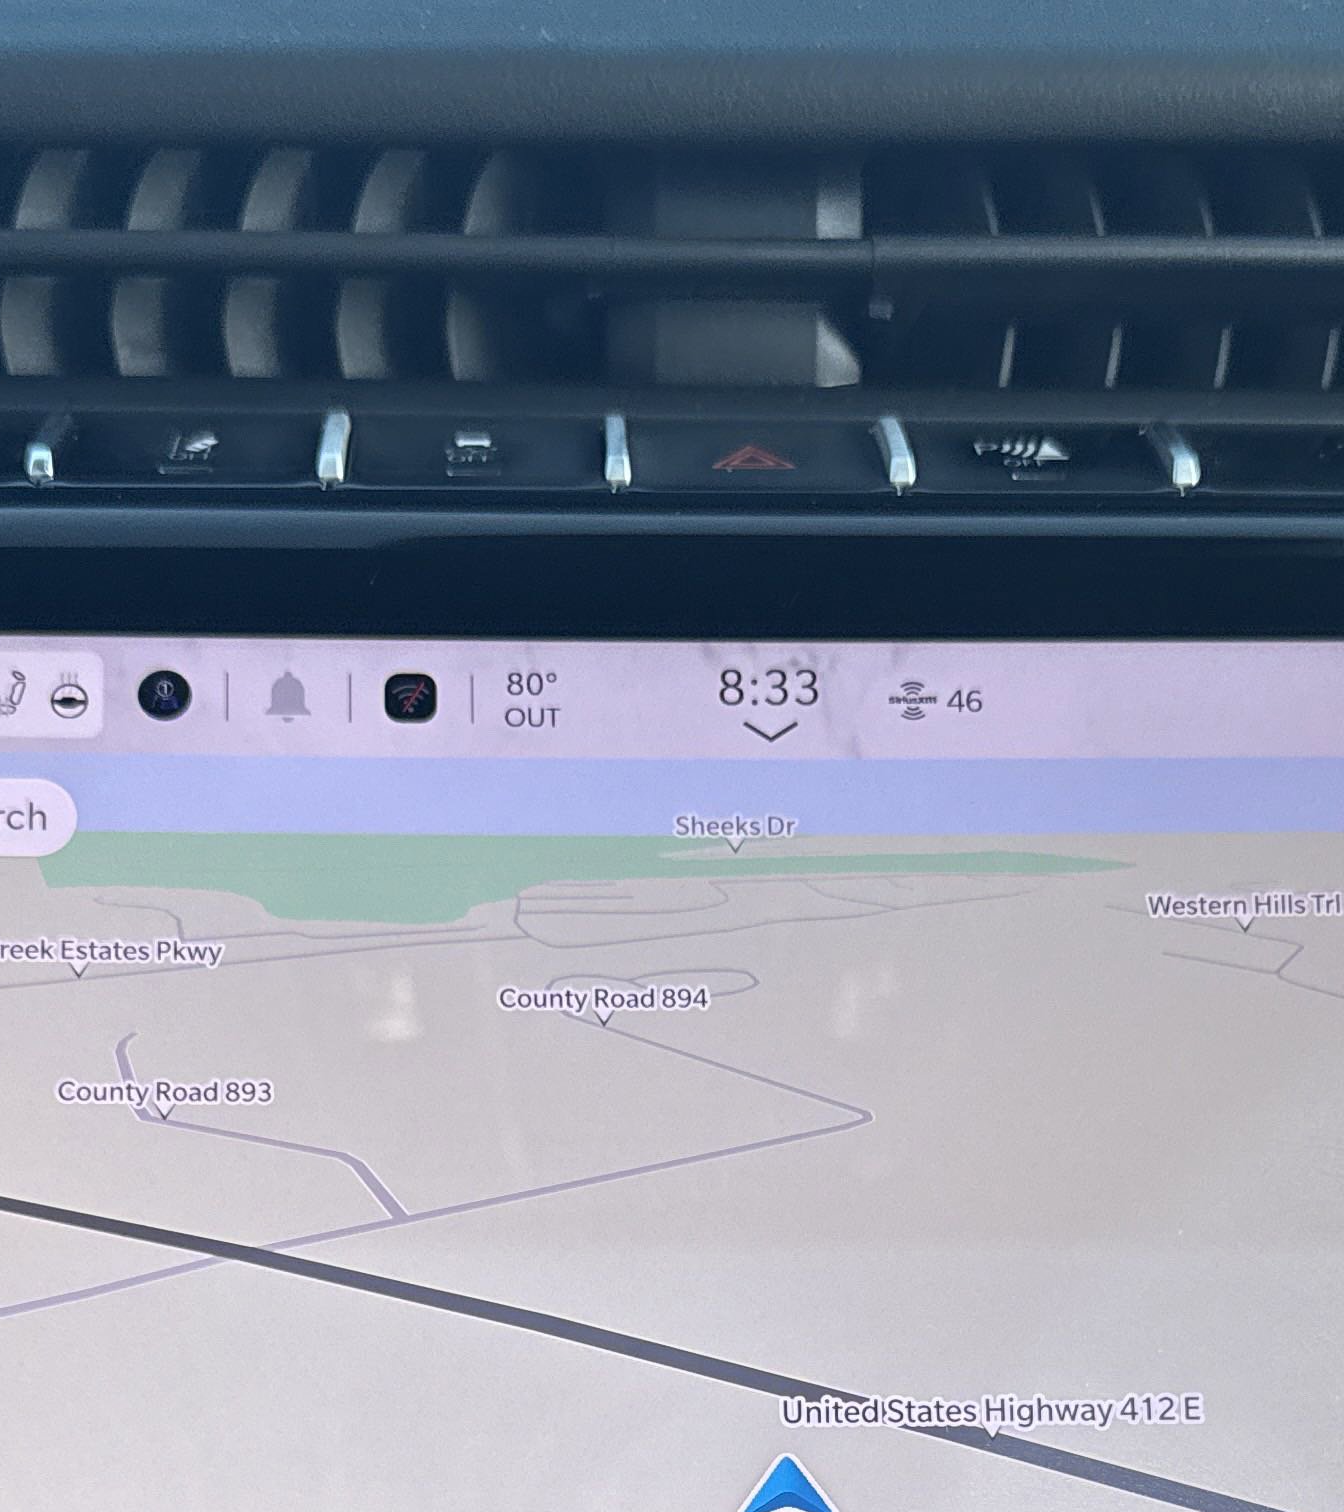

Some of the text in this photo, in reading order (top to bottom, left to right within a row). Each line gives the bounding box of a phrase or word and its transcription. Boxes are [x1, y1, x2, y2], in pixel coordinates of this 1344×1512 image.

[506, 672, 558, 697] 80°
[718, 669, 819, 707] 8:33
[946, 689, 983, 713] 46
[504, 706, 560, 730] OUT
[675, 816, 796, 837] Sheeks Dr
[1147, 893, 1342, 916] Western Hills Trl
[60, 940, 150, 962] Estates
[156, 941, 224, 967] Pkwy
[498, 987, 709, 1013] County Road 894
[57, 1080, 273, 1107] County Road 893
[783, 1397, 1200, 1427] United States Highway 412 E
